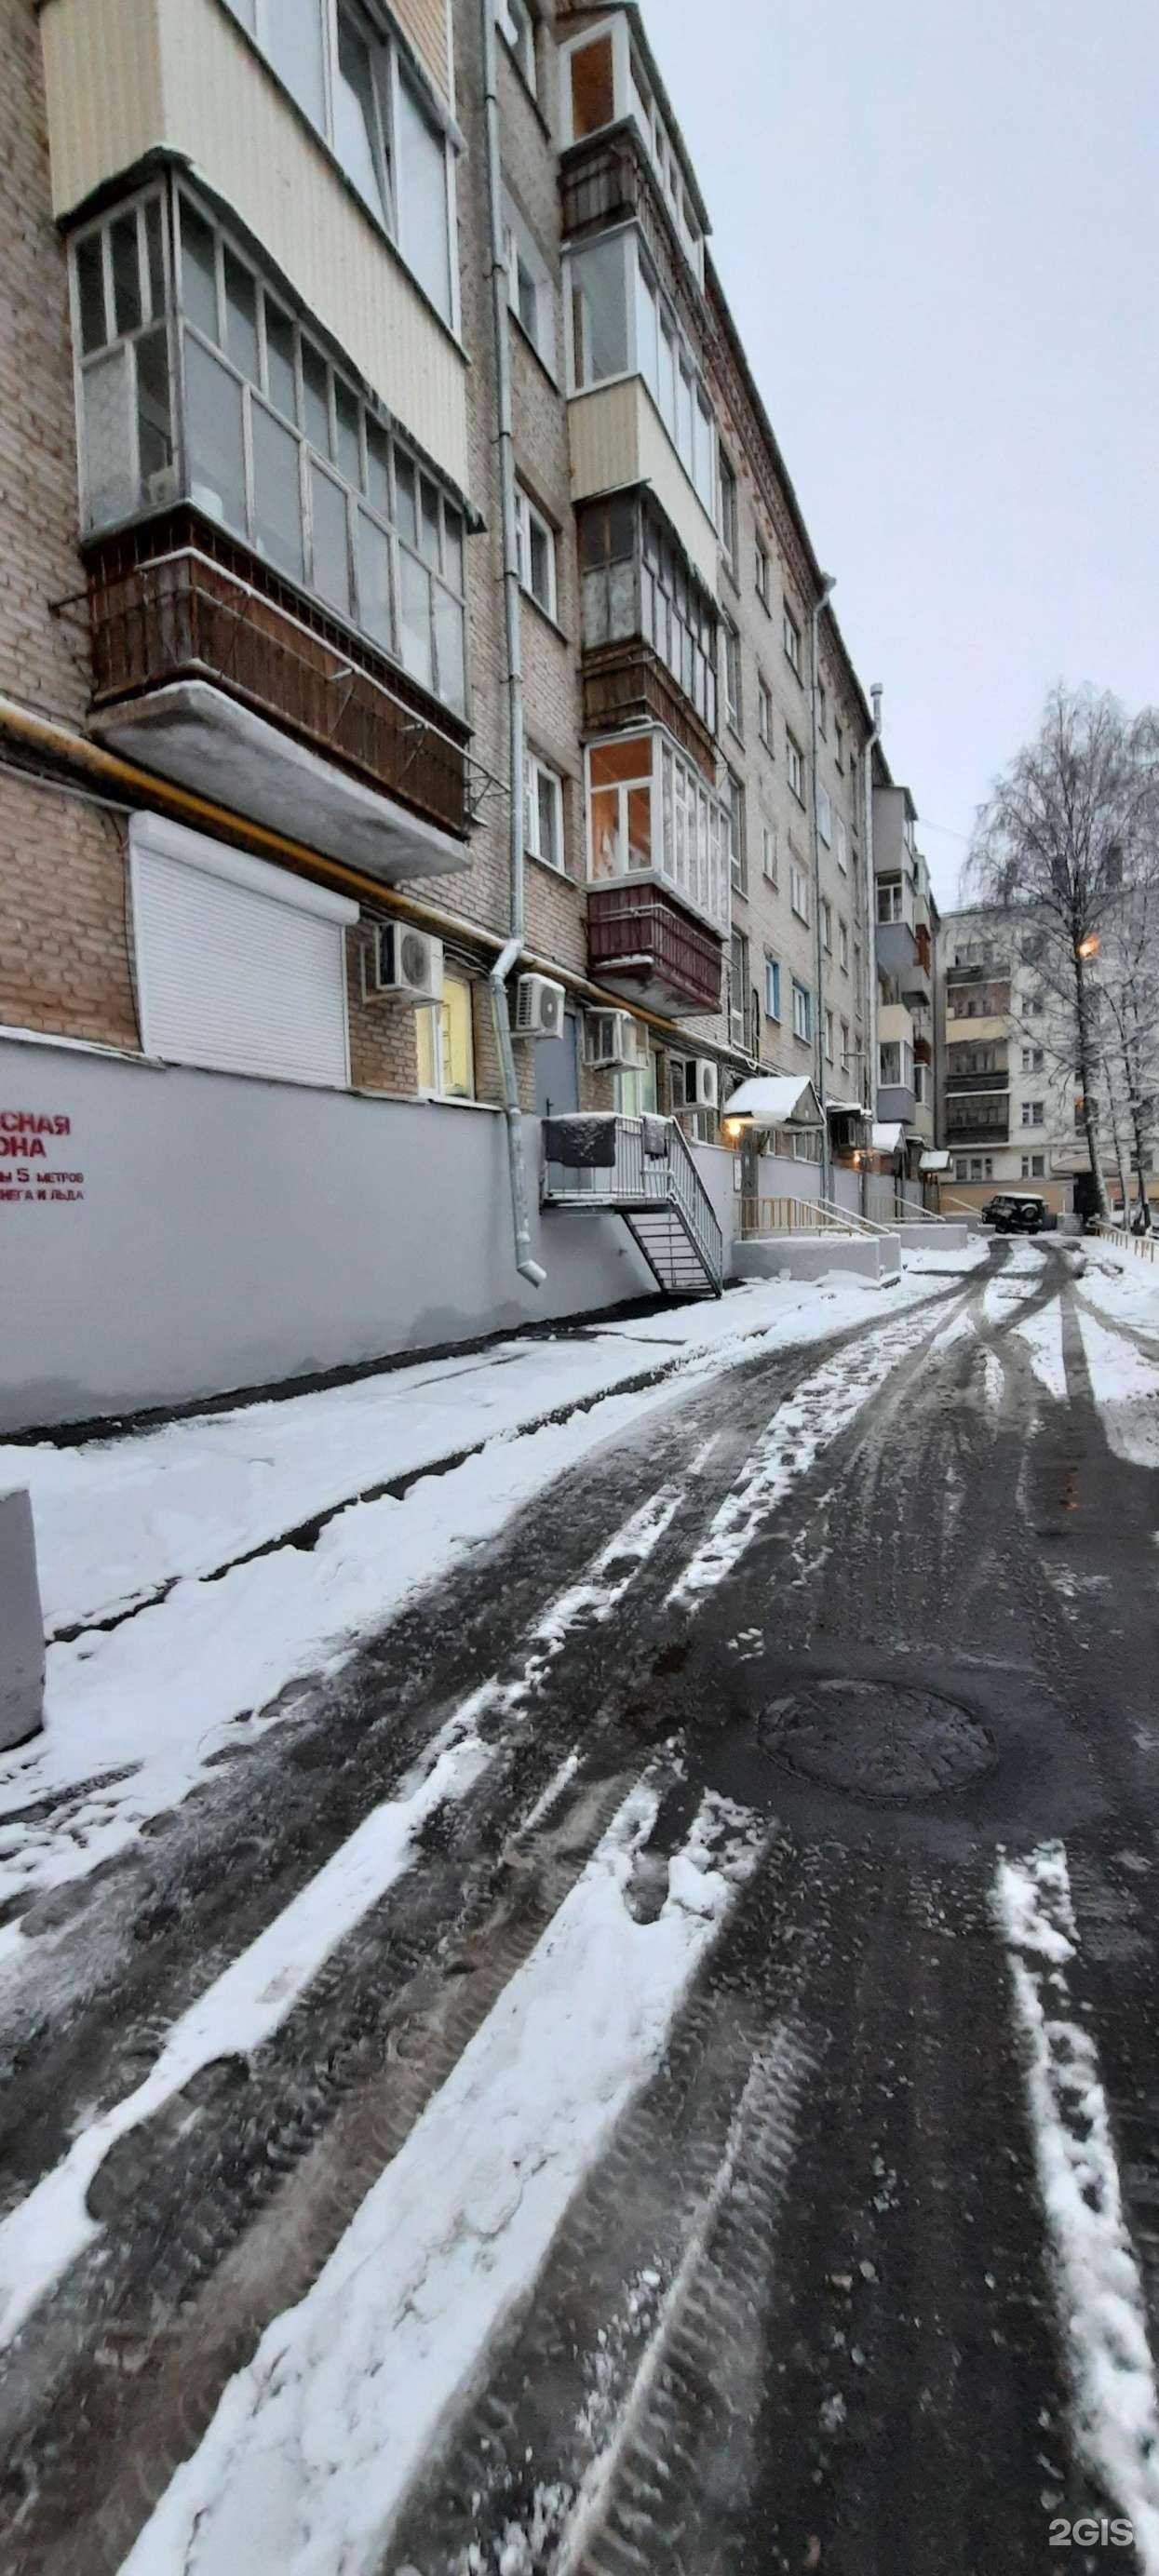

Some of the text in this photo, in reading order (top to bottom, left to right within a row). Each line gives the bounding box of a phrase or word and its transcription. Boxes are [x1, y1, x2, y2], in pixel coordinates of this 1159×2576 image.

[0, 1111, 71, 1135] СНАЯ
[16, 1168, 30, 1183] 5
[36, 1172, 85, 1184] МЕТРОВ
[37, 1188, 47, 1201] И
[50, 1189, 85, 1201] ЛЬДА
